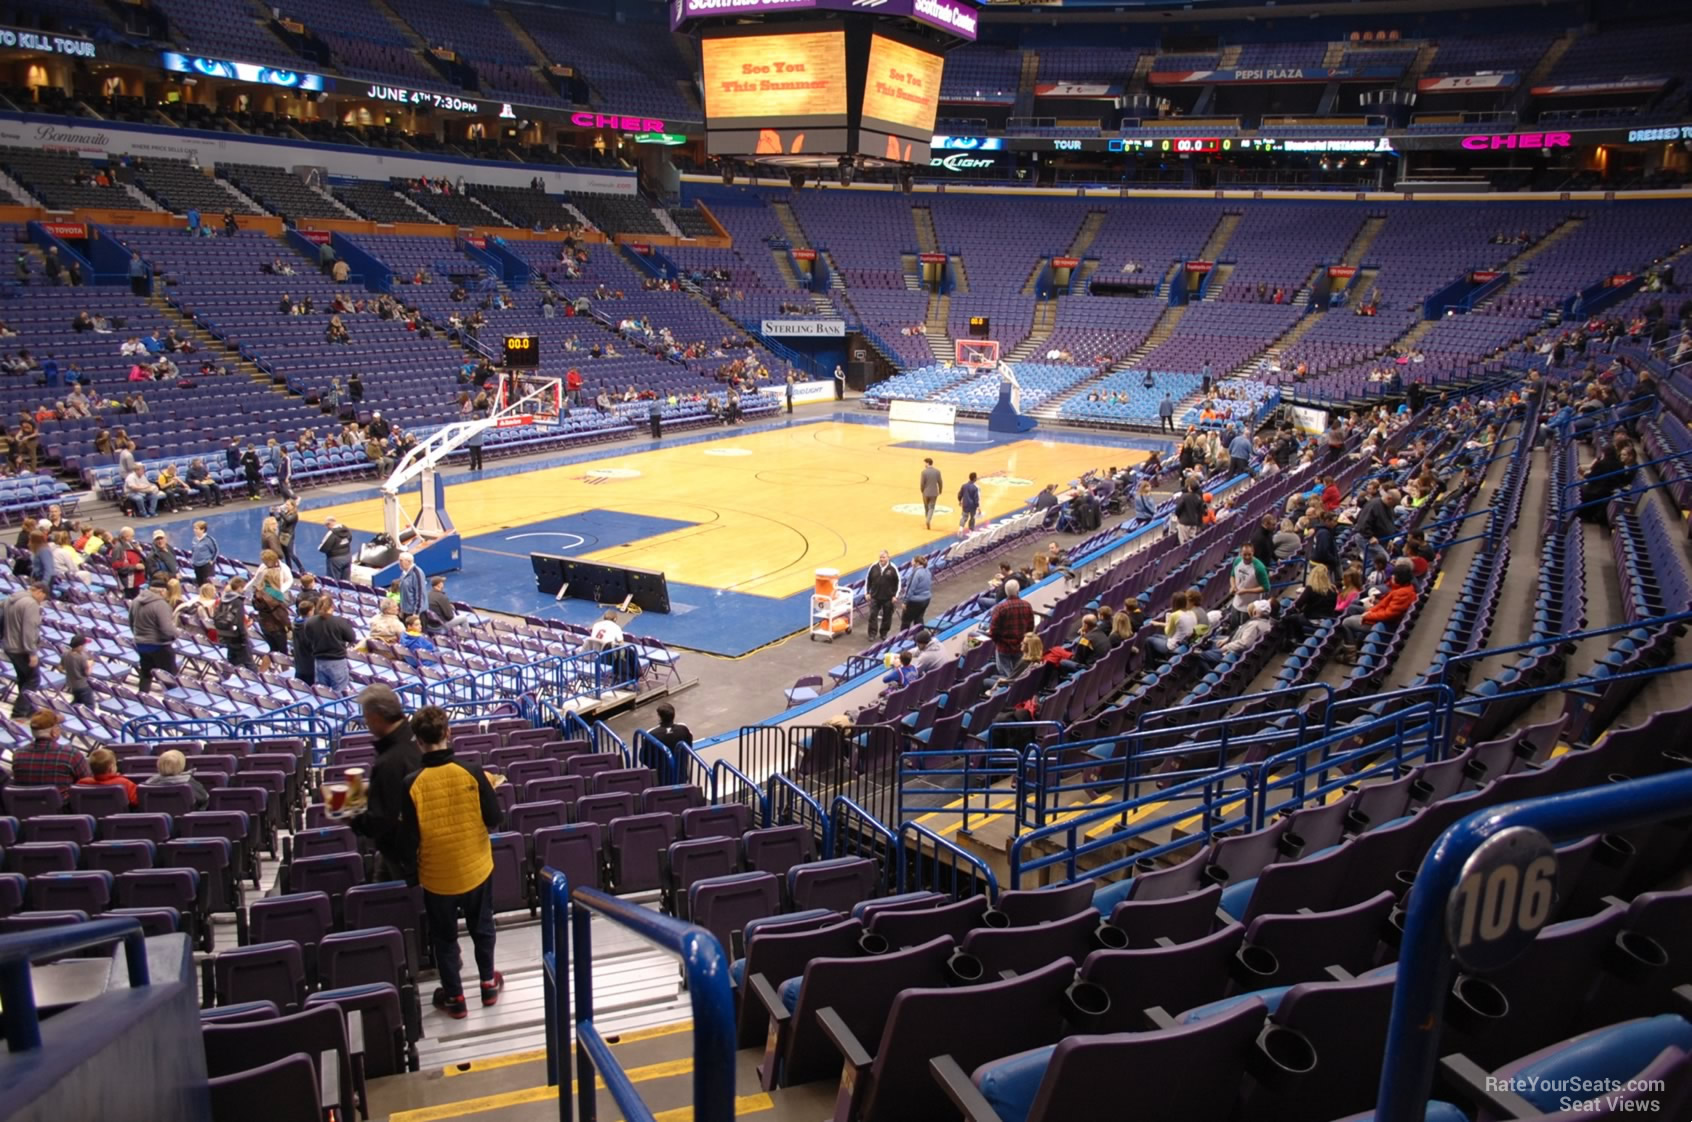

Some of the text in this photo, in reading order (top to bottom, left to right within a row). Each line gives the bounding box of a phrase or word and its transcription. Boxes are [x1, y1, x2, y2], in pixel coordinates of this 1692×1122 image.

[18, 33, 53, 51] KILL
[54, 38, 96, 57] TOUR
[742, 62, 805, 75] See You
[1235, 69, 1303, 79] PEPSI PLAZA
[721, 80, 831, 92] This Summer
[906, 73, 922, 87] You
[367, 85, 407, 103] JUNE
[433, 95, 477, 112] 7:30PM
[571, 112, 664, 133] CHER
[34, 126, 110, 147] Bommarito
[1461, 132, 1571, 150] CHER
[1628, 128, 1680, 142] DRESSED
[1054, 140, 1082, 150] TOUR
[1161, 140, 1169, 151] 0
[1177, 140, 1203, 151] 00.0
[1223, 139, 1231, 150] 0
[951, 159, 995, 168] LIGHT
[55, 227, 83, 235] TOYOTA
[507, 338, 529, 350] 00.0
[1458, 857, 1556, 946] 106
